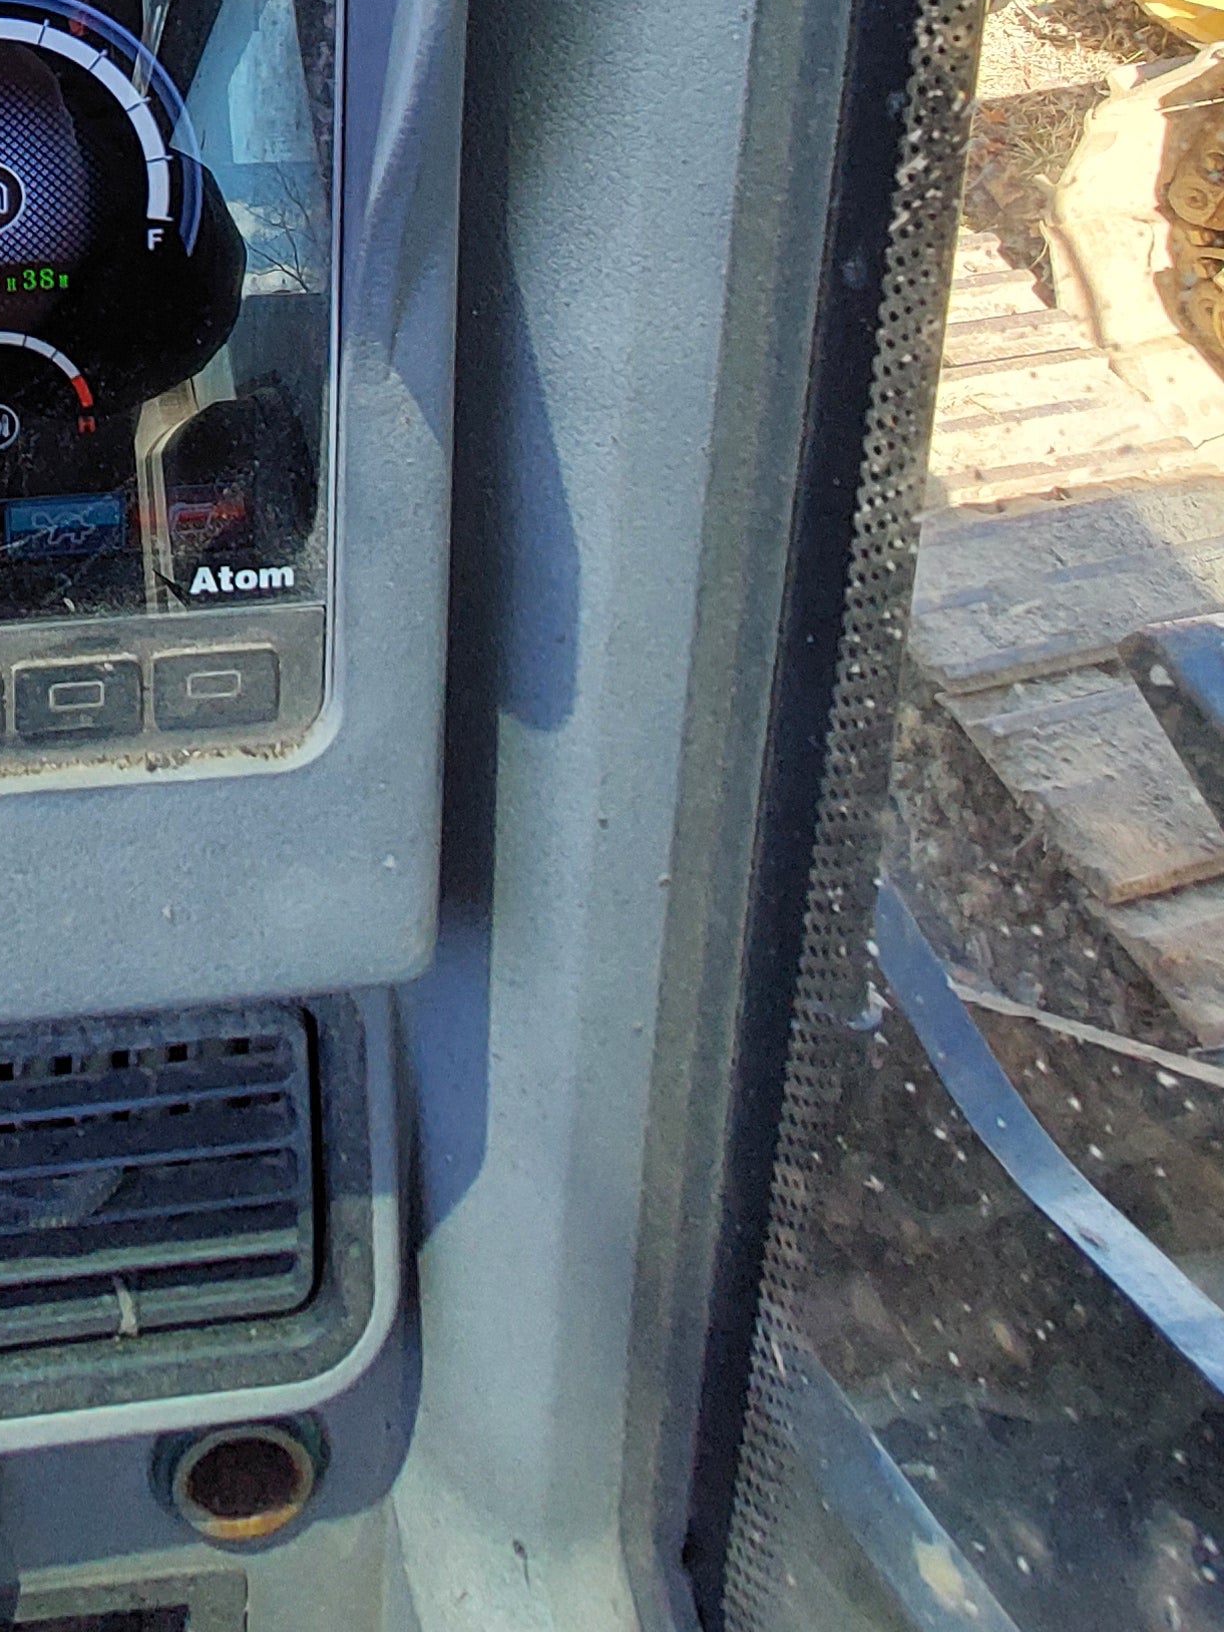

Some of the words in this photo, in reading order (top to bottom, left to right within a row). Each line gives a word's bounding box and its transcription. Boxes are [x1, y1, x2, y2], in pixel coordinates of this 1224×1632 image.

[147, 228, 165, 251] F
[78, 415, 97, 434] H
[189, 566, 295, 595] Atom
